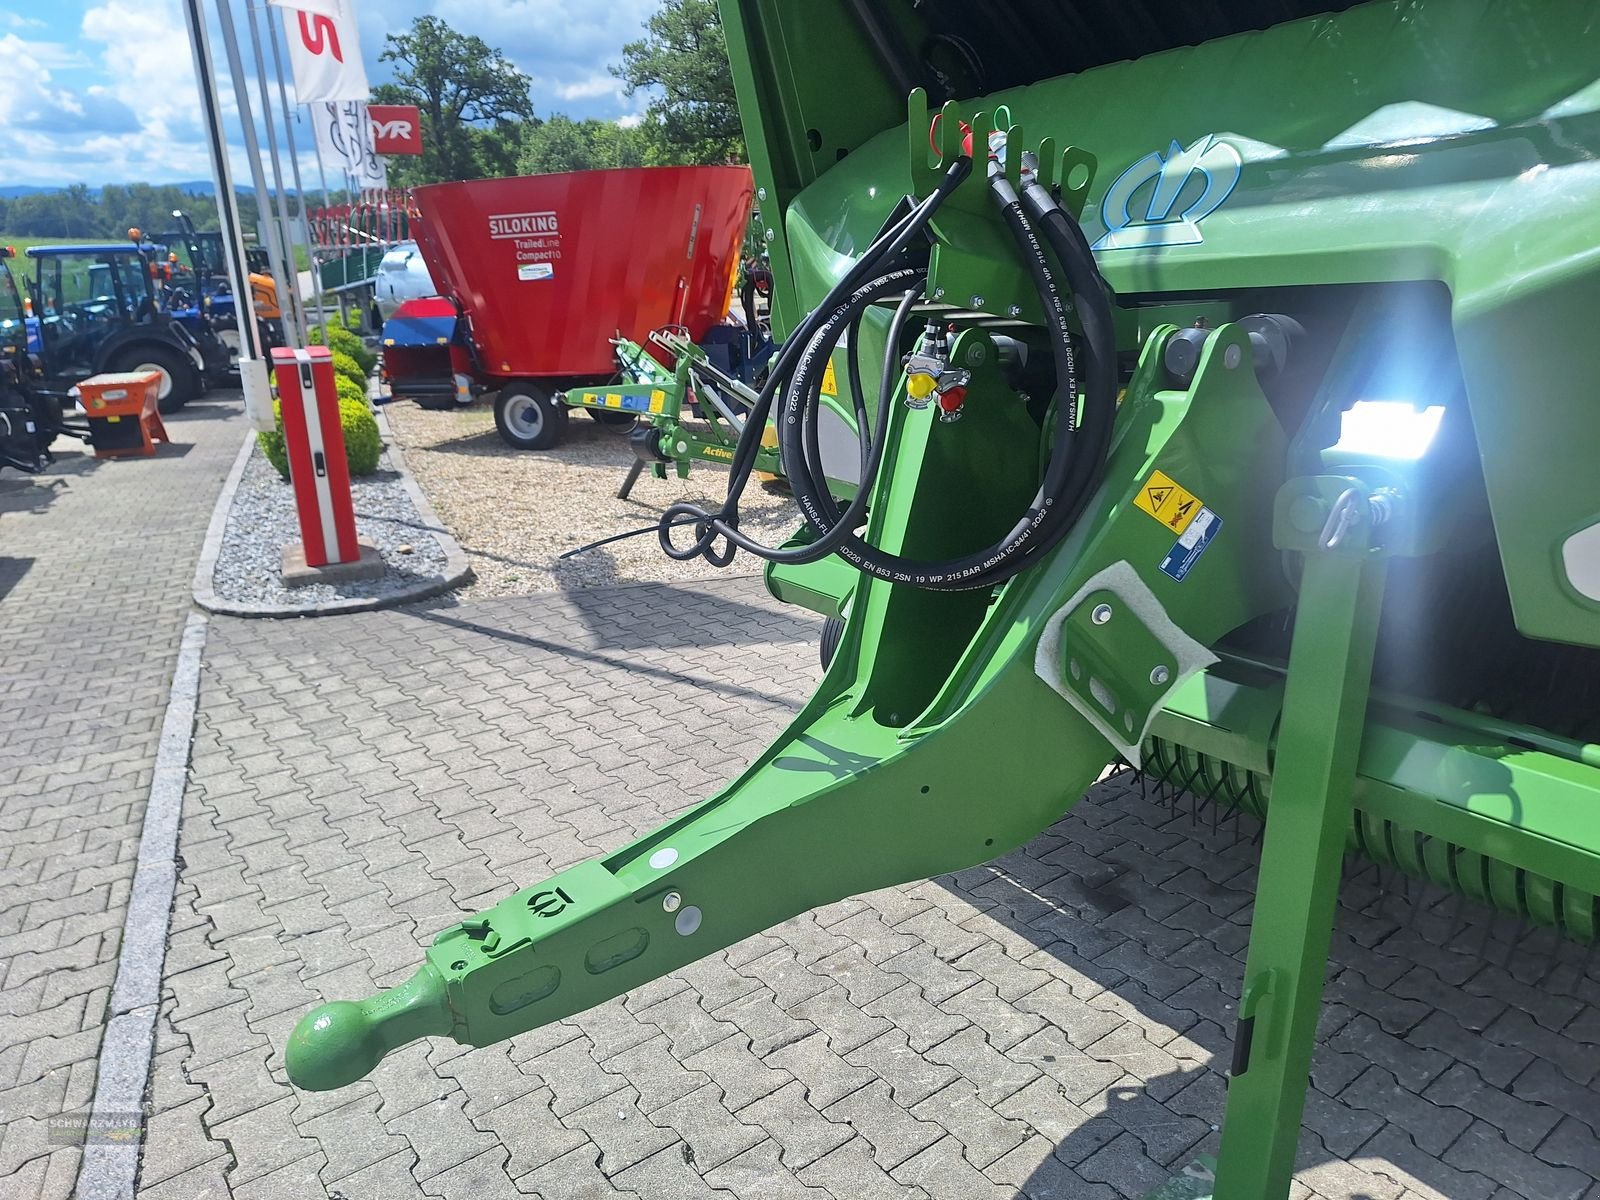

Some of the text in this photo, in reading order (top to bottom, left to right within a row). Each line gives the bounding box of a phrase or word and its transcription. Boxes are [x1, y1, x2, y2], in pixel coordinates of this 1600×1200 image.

[489, 216, 558, 235] SILOKING
[1028, 233, 1040, 250] BAR
[1042, 267, 1052, 281] WP
[1062, 331, 1071, 344] EN
[1065, 347, 1076, 374] HD220
[1067, 377, 1077, 432] HANSA-FLEX
[703, 446, 735, 459] Active
[801, 495, 829, 536] HANSA-FL
[863, 560, 876, 572] EN
[876, 567, 891, 578] 853
[894, 572, 911, 582] 2SN
[915, 575, 925, 583] 19
[929, 575, 943, 583] WP
[946, 571, 961, 581] 215
[963, 565, 981, 577] BAR
[983, 551, 1006, 569] MSHA
[1005, 528, 1032, 555] IC-84/41
